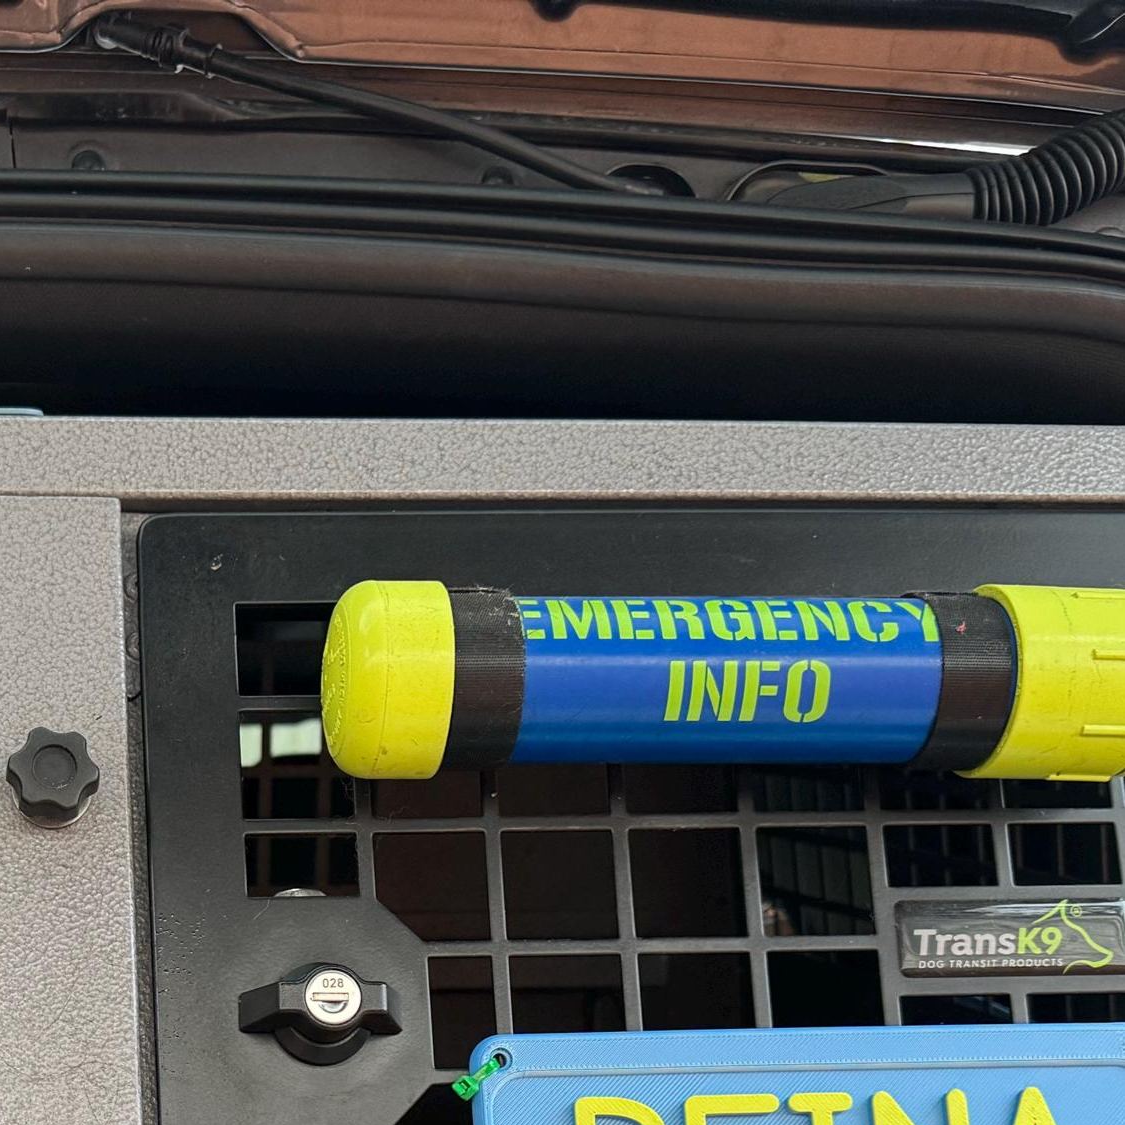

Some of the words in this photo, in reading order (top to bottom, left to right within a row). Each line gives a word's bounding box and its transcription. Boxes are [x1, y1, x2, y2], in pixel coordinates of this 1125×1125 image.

[663, 659, 832, 724] INFO
[913, 926, 1063, 956] TransK9
[918, 961, 945, 969] DOG
[949, 959, 997, 968] TRANSIT
[1001, 958, 1064, 968] PRODUCTS
[322, 977, 345, 989] 028
